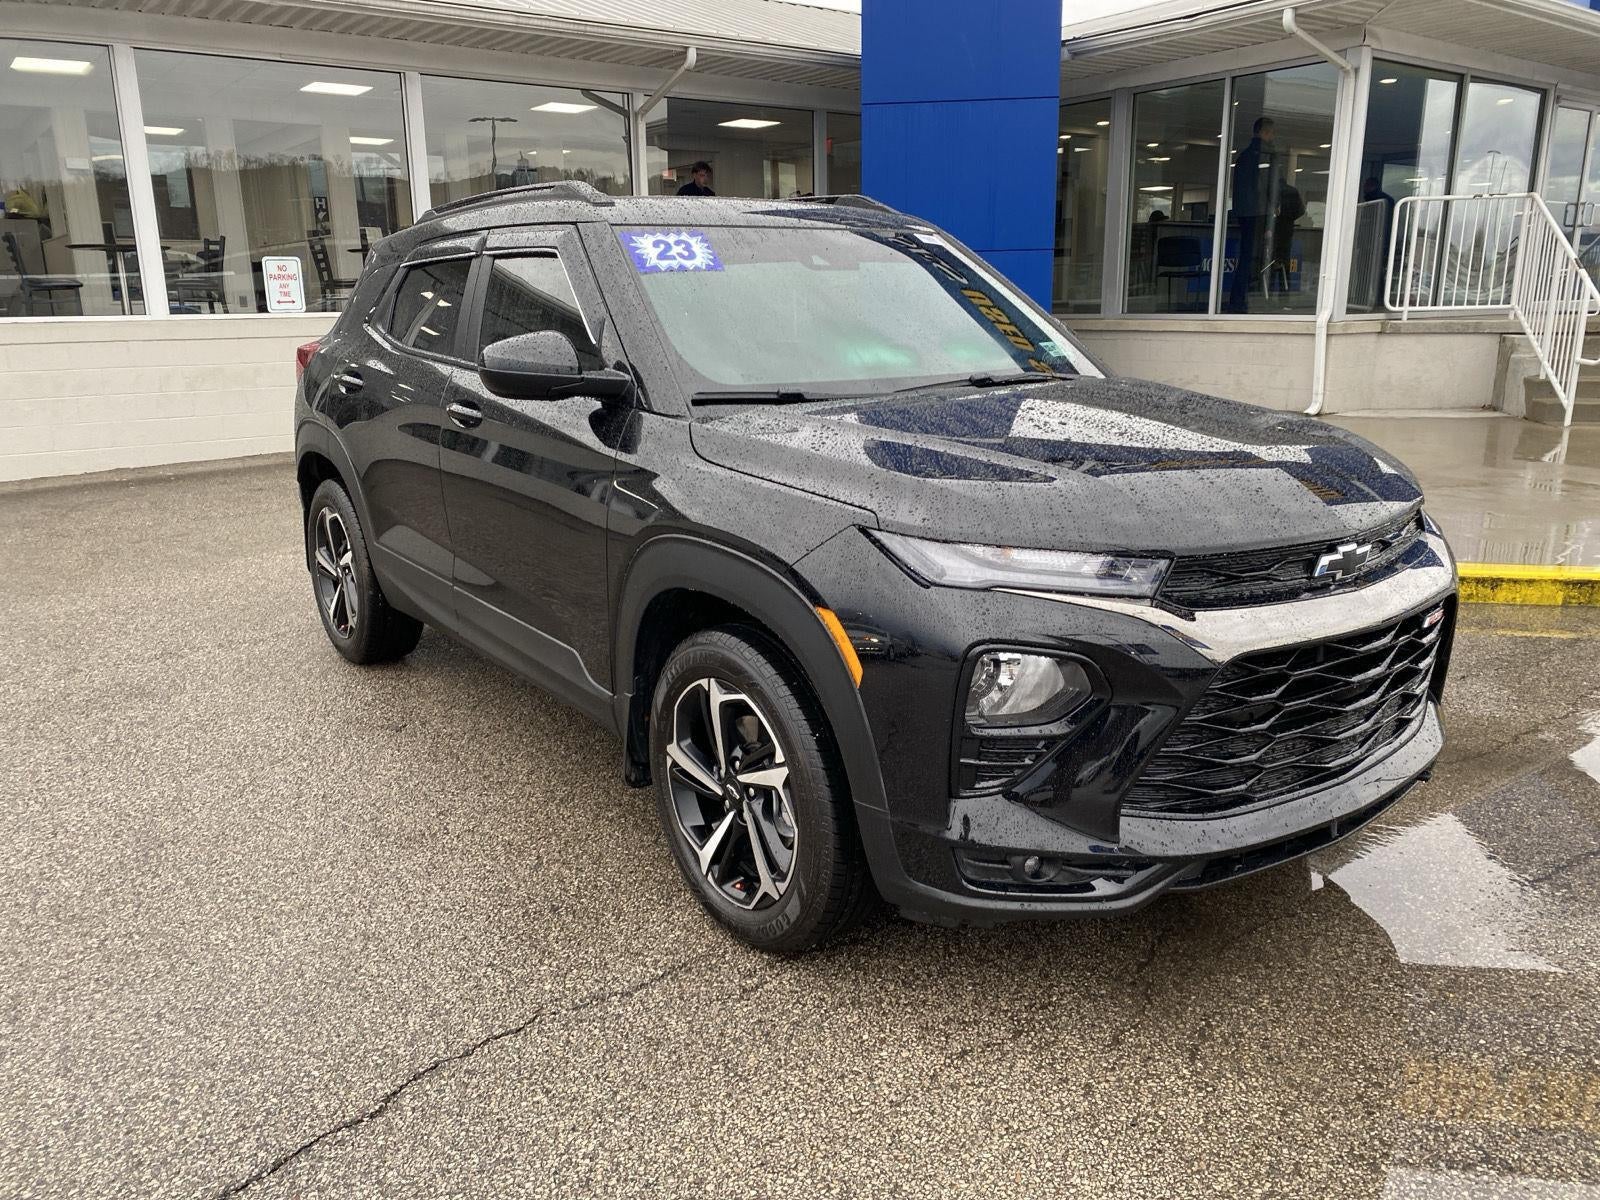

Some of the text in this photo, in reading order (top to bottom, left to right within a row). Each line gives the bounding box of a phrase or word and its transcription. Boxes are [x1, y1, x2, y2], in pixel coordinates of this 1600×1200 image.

[651, 238, 698, 262] 23
[277, 264, 288, 272] NO
[268, 273, 298, 281] PARKING
